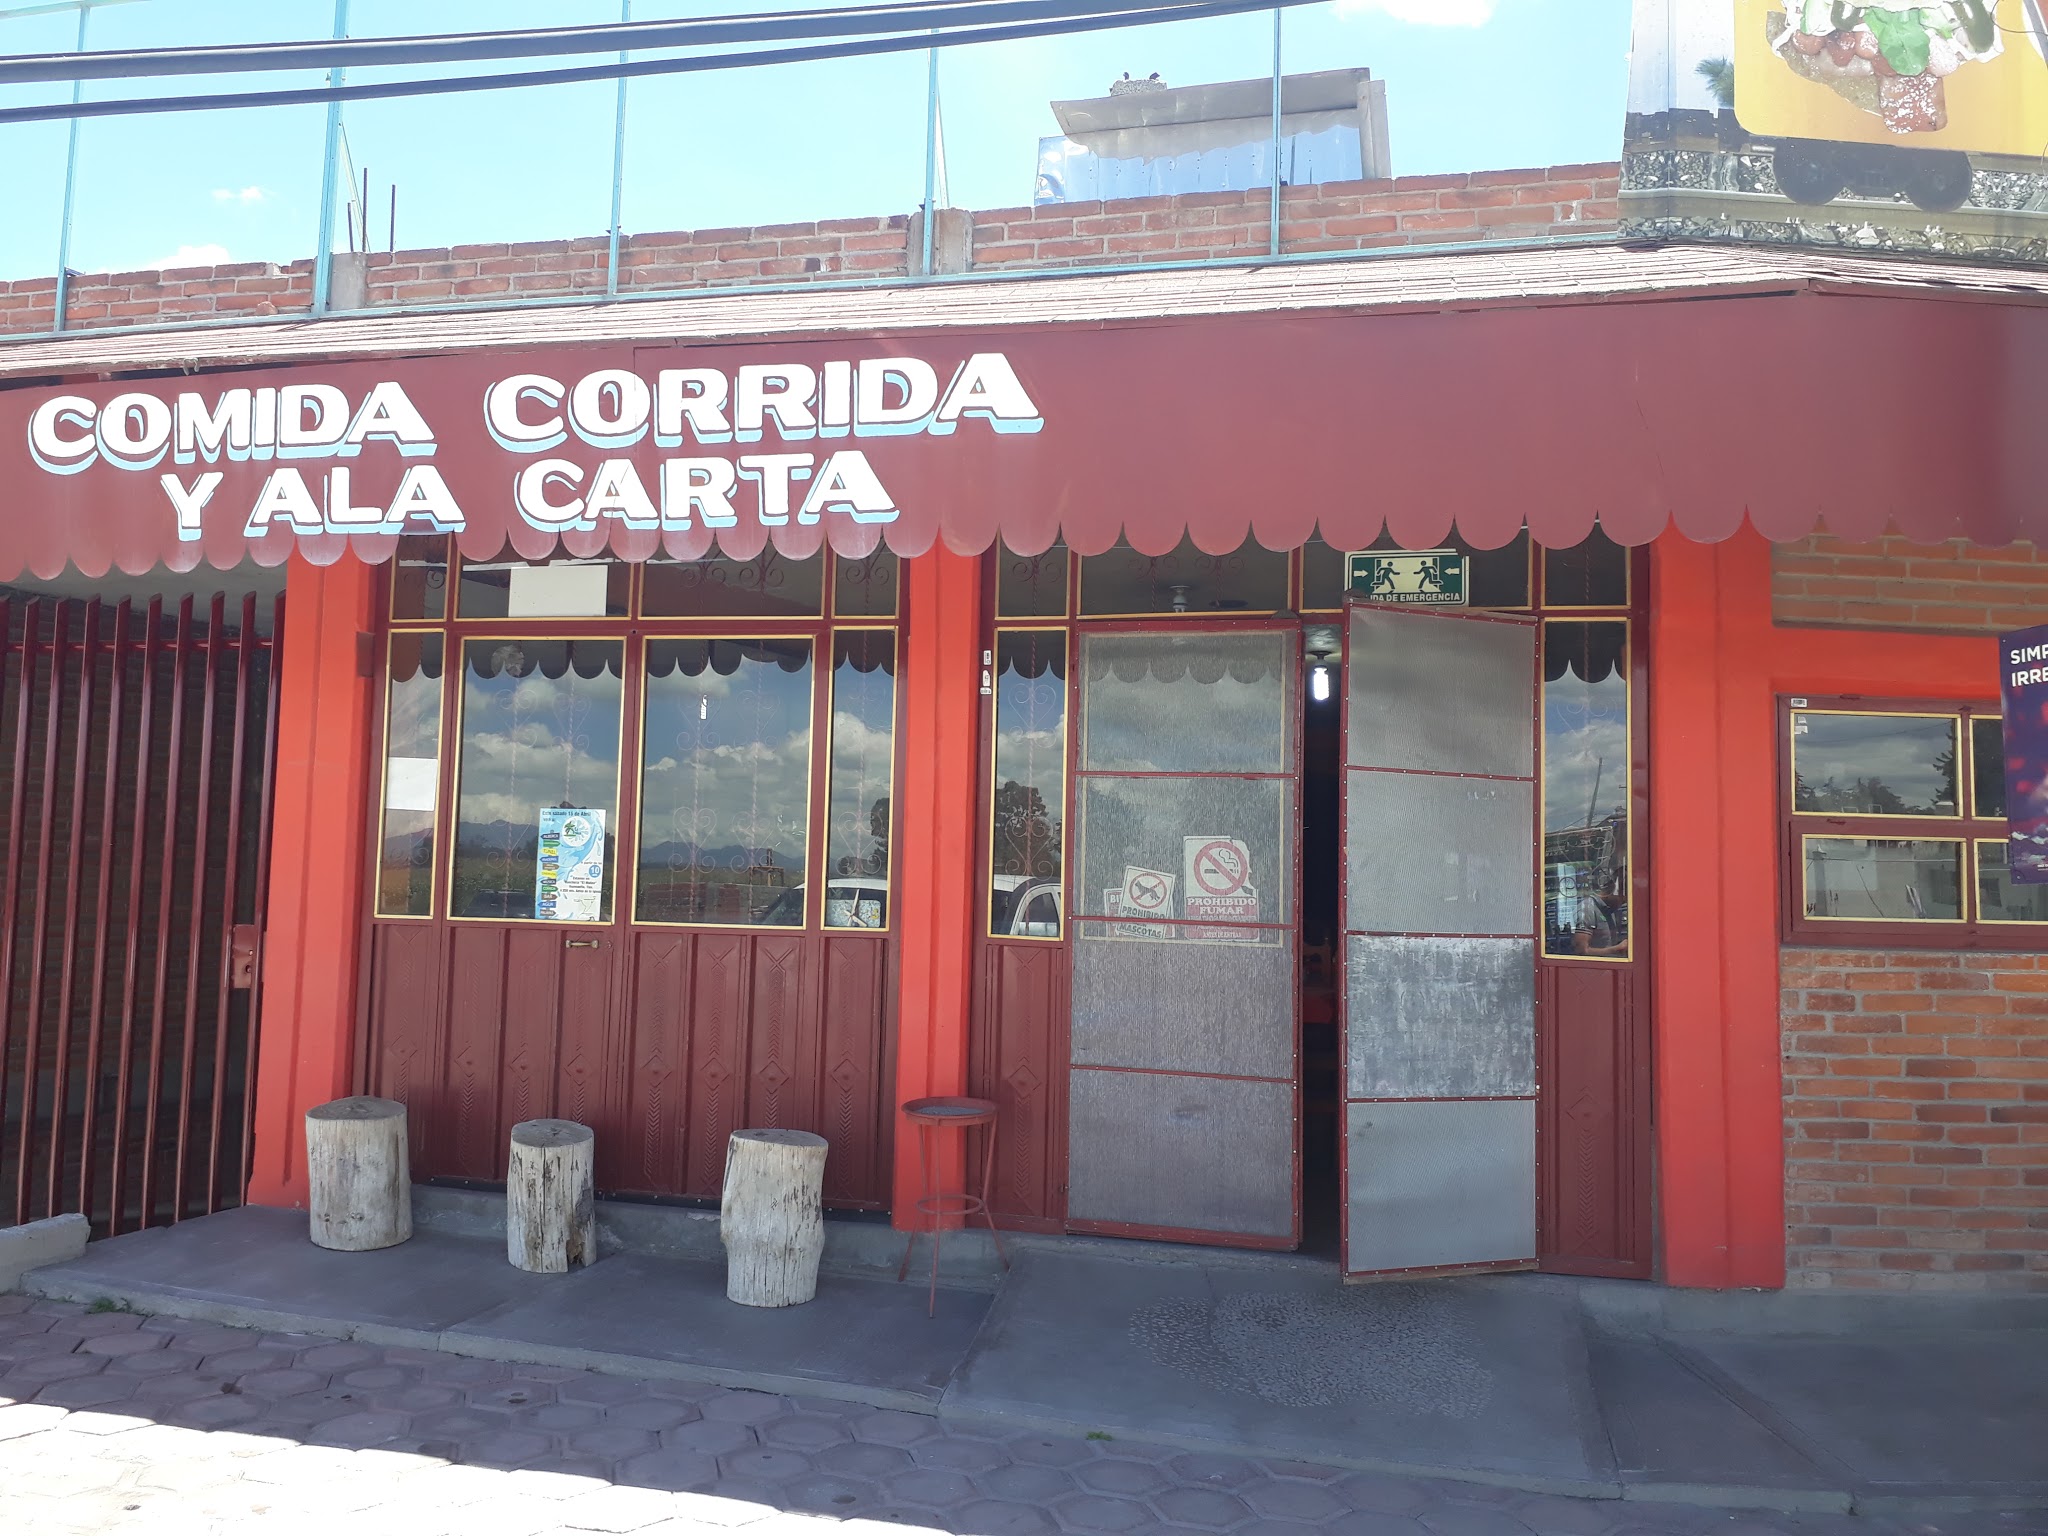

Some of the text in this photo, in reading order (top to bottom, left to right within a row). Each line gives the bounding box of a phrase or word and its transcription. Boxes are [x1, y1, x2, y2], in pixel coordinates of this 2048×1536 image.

[28, 353, 1044, 475] COMIDA CORRIDA
[161, 471, 224, 541] Y
[514, 450, 900, 532] CARTA
[1386, 594, 1398, 602] DE
[1400, 593, 1460, 602] EMERGENCIA
[2011, 667, 2048, 687] IRRE
[1187, 898, 1257, 906] PROHIBIDO
[1200, 906, 1244, 914] FUMAR
[1117, 922, 1162, 938] MASCOTAS
